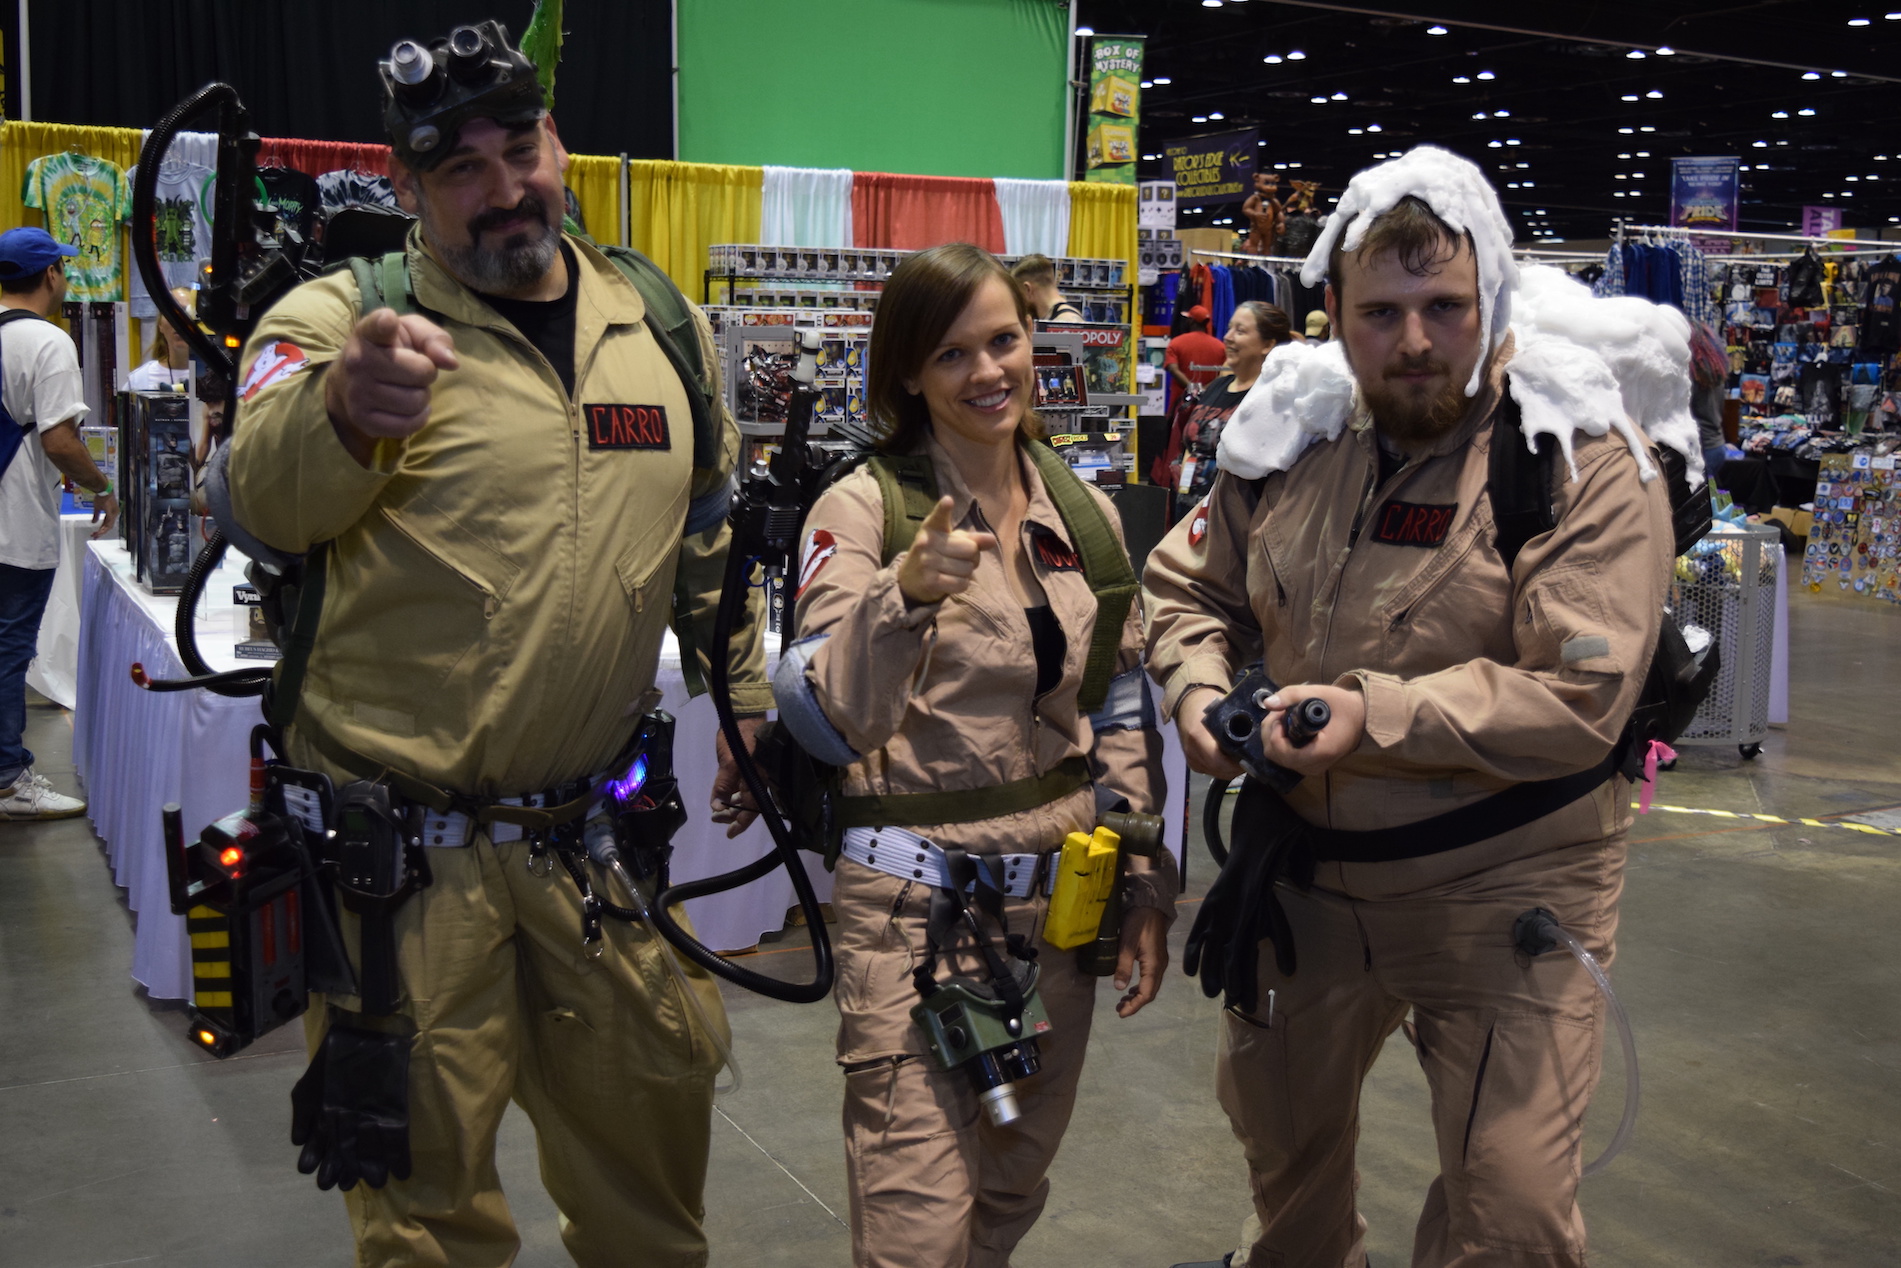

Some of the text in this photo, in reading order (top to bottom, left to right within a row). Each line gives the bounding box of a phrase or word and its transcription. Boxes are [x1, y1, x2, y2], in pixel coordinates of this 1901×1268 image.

[1094, 45, 1140, 59] BOX OF
[1095, 59, 1140, 73] MYSTERY
[1680, 205, 1728, 220] PRIDE
[592, 407, 662, 444] CARRO
[1380, 504, 1451, 542] CARRO
